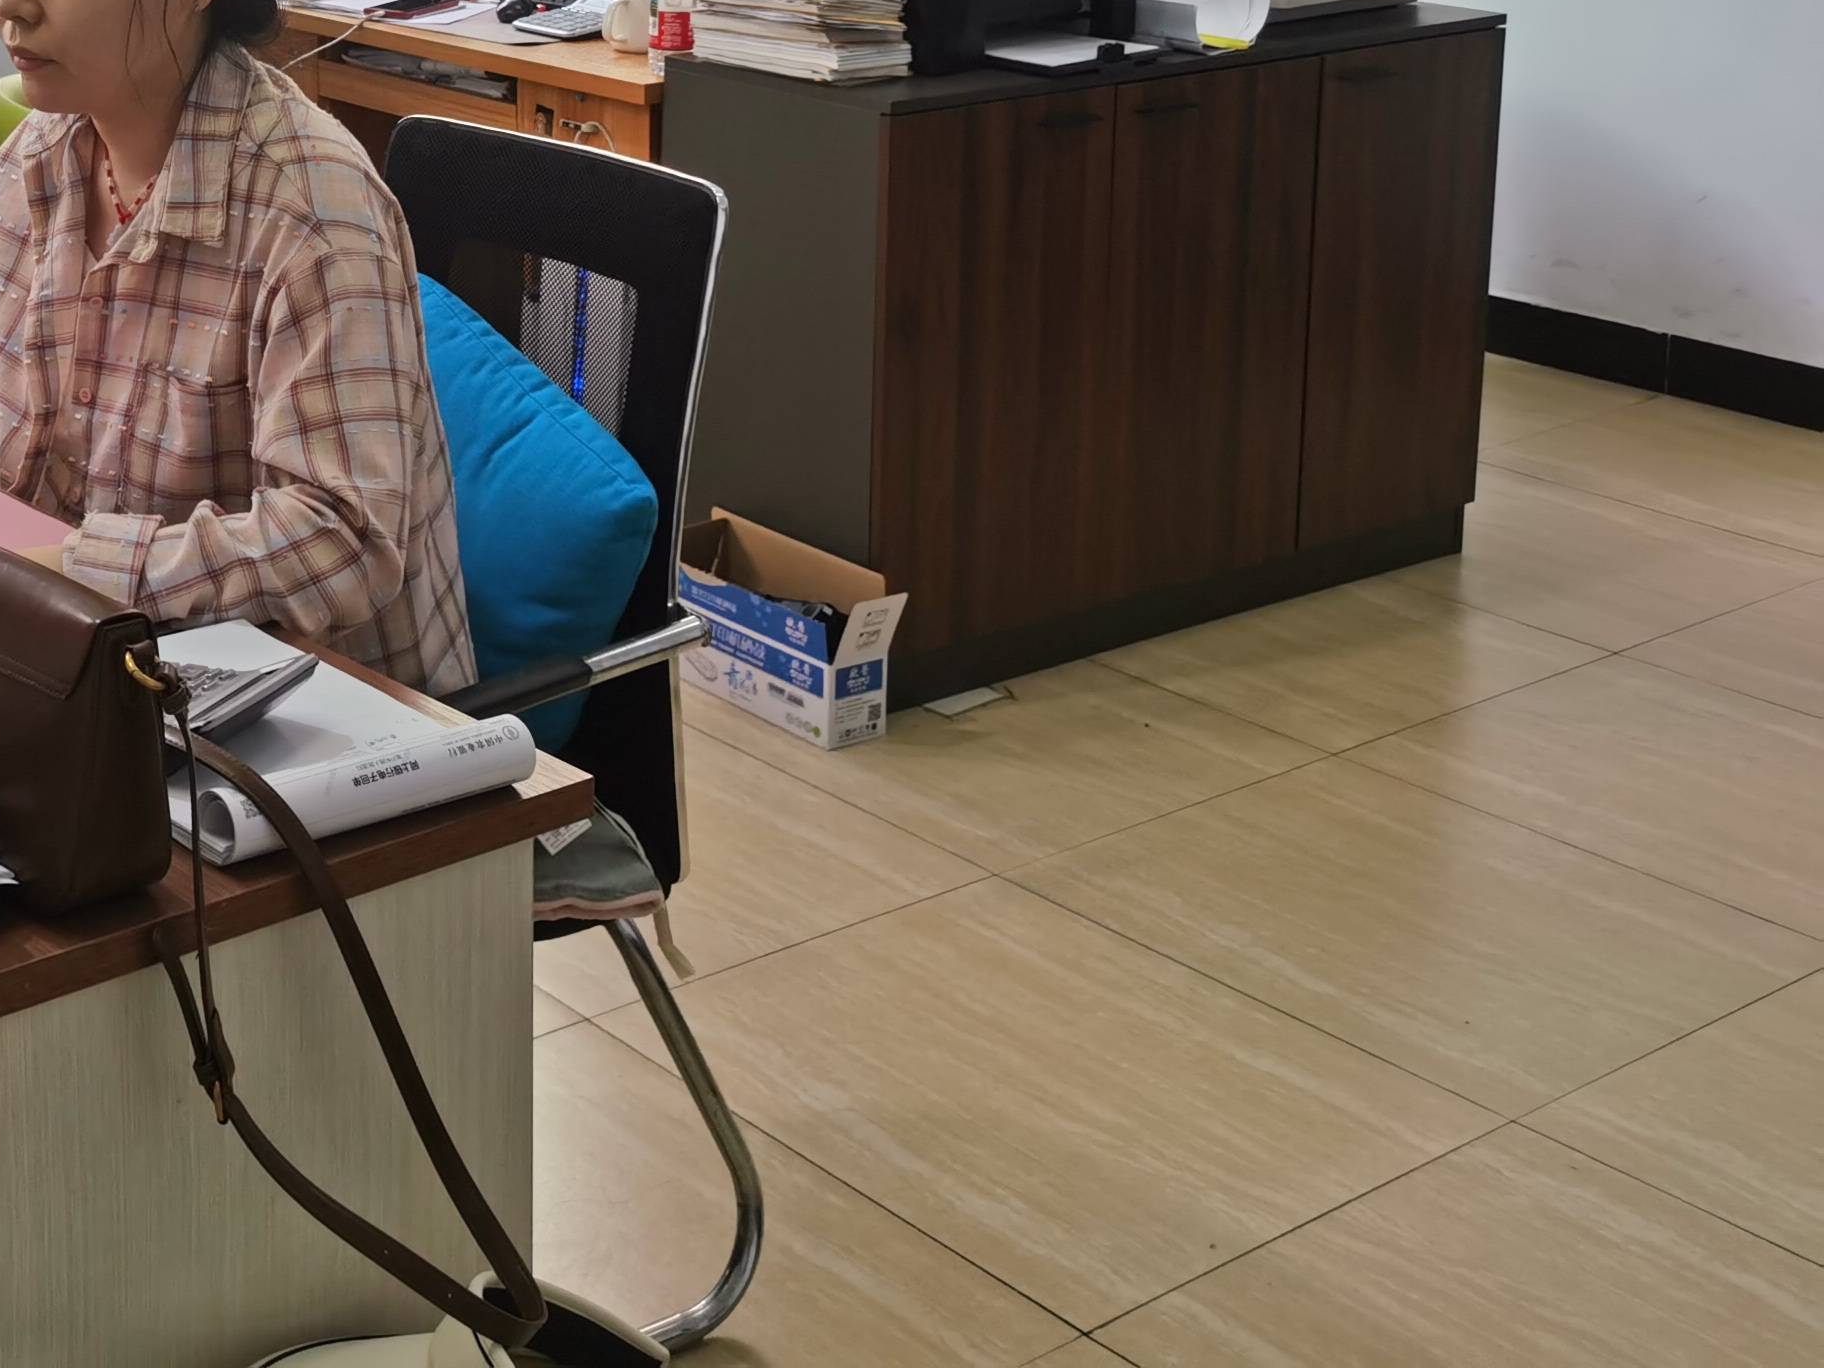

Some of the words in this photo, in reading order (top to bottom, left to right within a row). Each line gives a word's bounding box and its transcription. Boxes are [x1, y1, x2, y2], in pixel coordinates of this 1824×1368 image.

[447, 734, 504, 759] 中国农业银行
[351, 759, 420, 788] 网上银行电子回单
